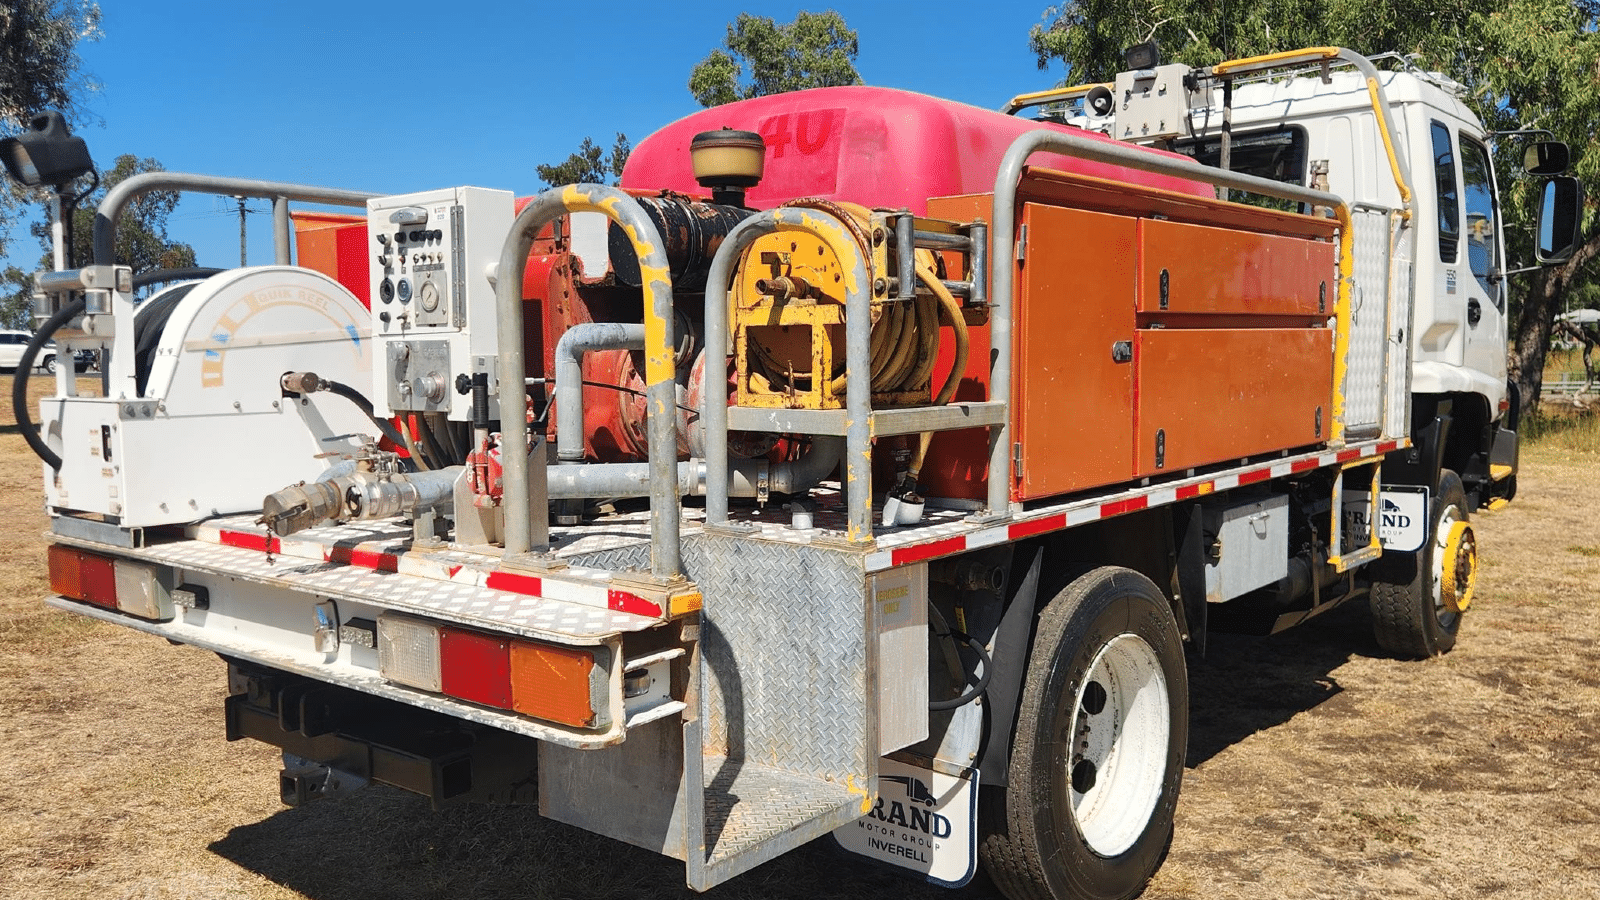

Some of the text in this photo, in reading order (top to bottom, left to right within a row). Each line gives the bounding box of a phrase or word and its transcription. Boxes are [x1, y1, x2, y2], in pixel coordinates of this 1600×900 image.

[297, 290, 328, 311] REEL
[1348, 511, 1411, 528] RND
[884, 601, 900, 615] ONLY
[867, 795, 952, 840] RAND
[858, 820, 941, 852] MOTOR GROUP
[868, 836, 928, 864] INVERELL
